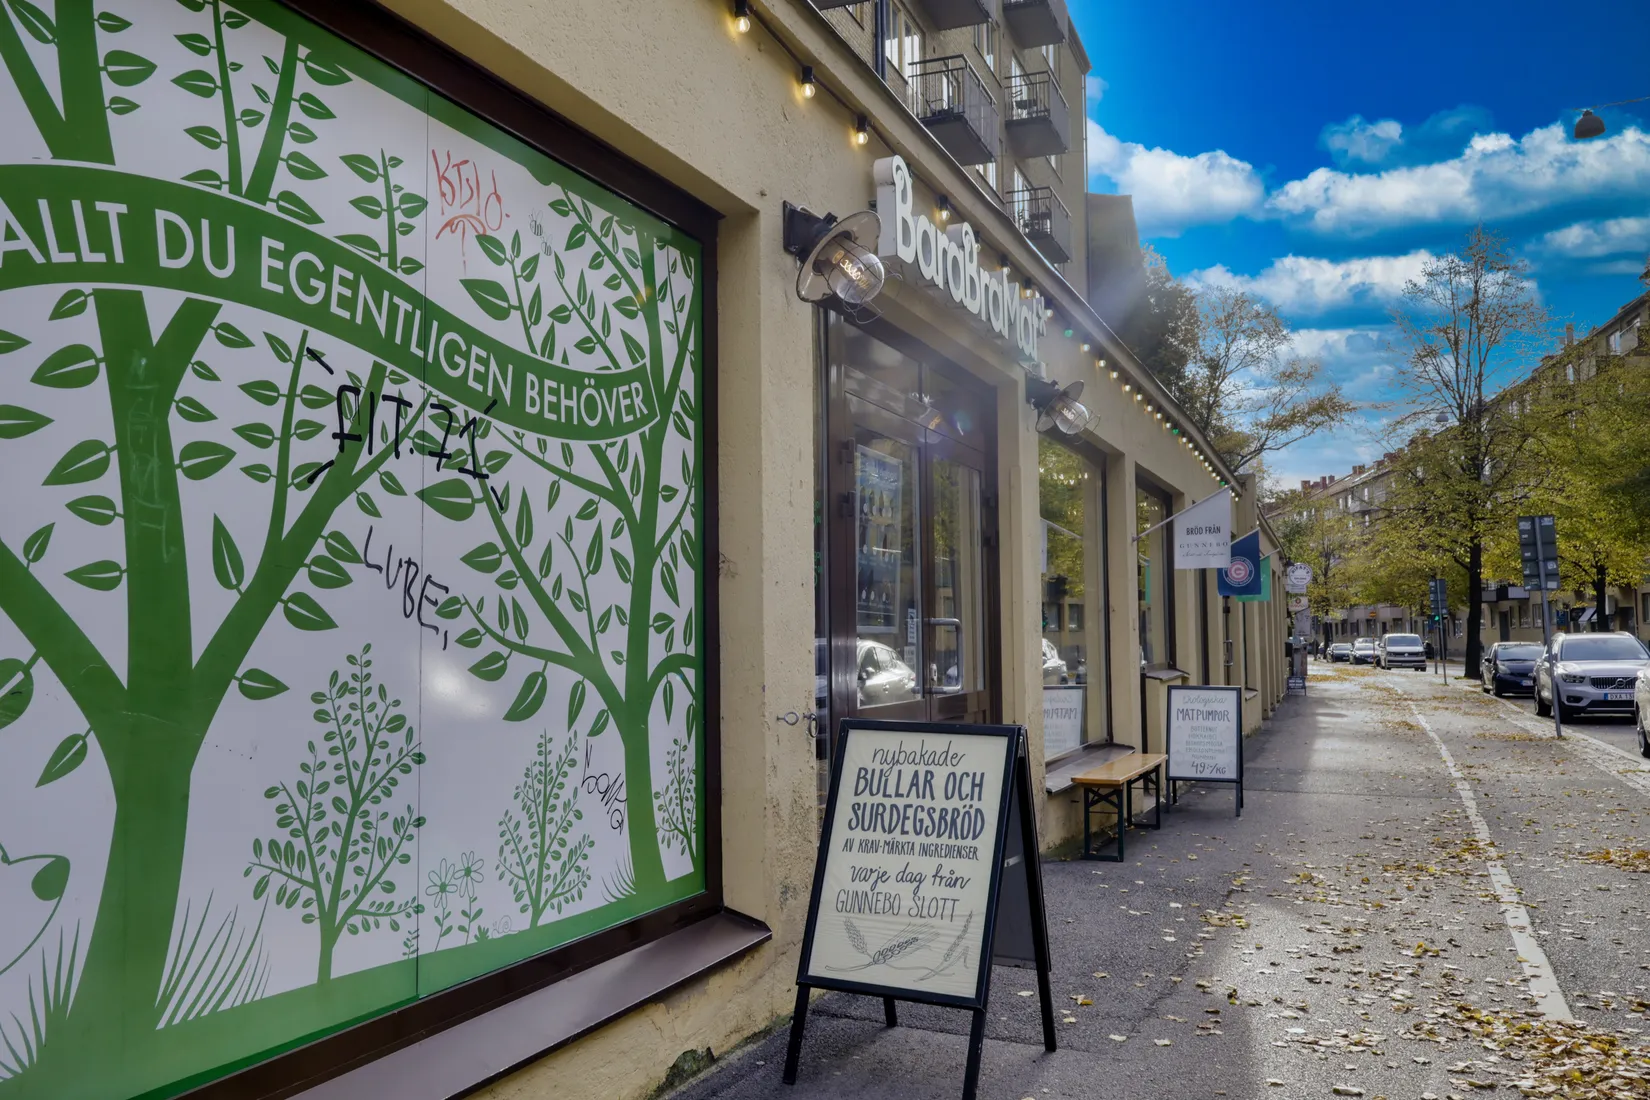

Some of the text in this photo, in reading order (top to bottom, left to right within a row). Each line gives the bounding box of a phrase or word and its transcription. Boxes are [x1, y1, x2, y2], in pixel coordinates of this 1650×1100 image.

[0, 199, 648, 428] ALLT DU EGENTLIGEN BEHÖVER
[1186, 524, 1221, 535] BRÖD FRÅN
[871, 739, 966, 777] nybakade
[853, 767, 985, 802] BULLAR OCH
[847, 802, 986, 841] SURDEGSBRÖD
[841, 837, 980, 861] AV KRAV-MÄRKTA INGREDIENSER
[850, 862, 971, 895] varje dag från
[835, 888, 960, 923] GUNNEBO SLOTT
